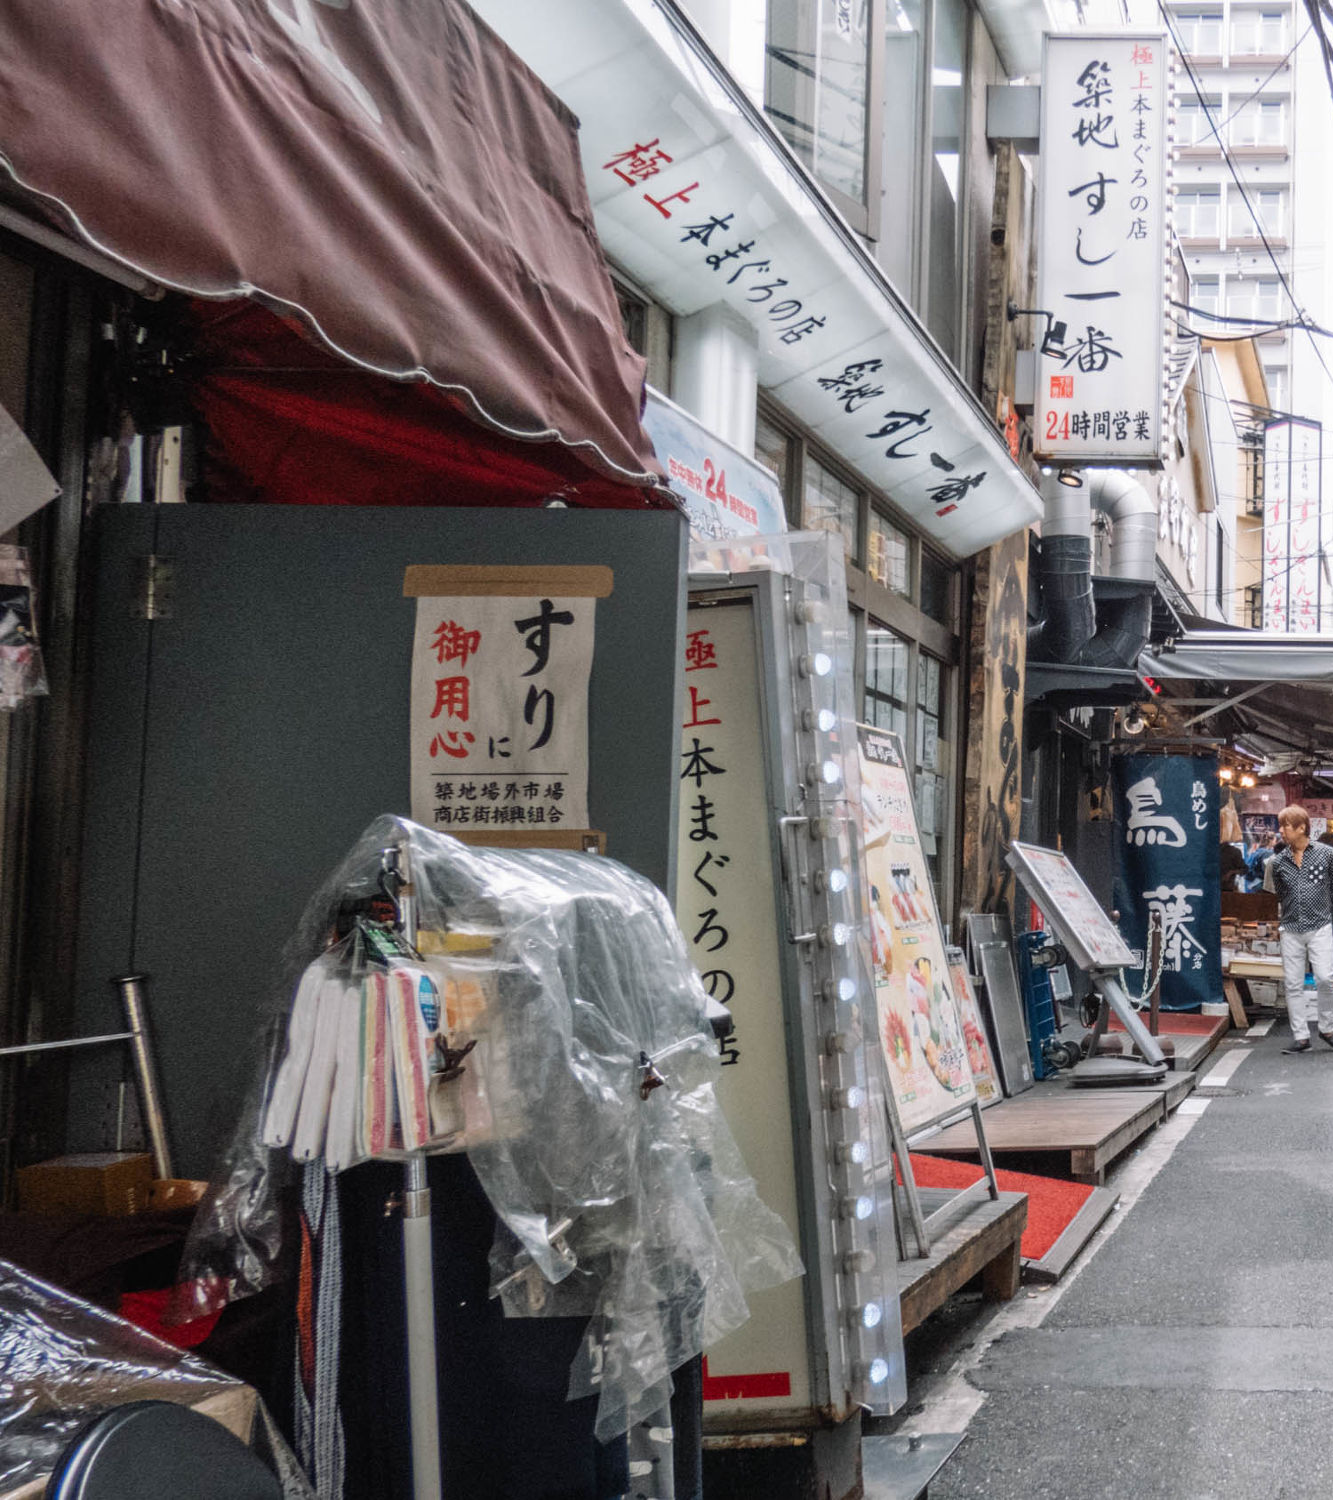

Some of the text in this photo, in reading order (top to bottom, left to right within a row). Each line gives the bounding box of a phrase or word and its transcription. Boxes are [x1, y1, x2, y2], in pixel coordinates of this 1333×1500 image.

[1127, 43, 1153, 240] 極上本まぐろの店
[1061, 60, 1123, 373] 築地すし一番
[1046, 410, 1151, 441] 24時間営業
[429, 620, 481, 759] 御用心
[433, 806, 565, 824] 商店街振興組合
[434, 782, 565, 800] 築地場外市場
[1191, 780, 1208, 830] 鳥めし
